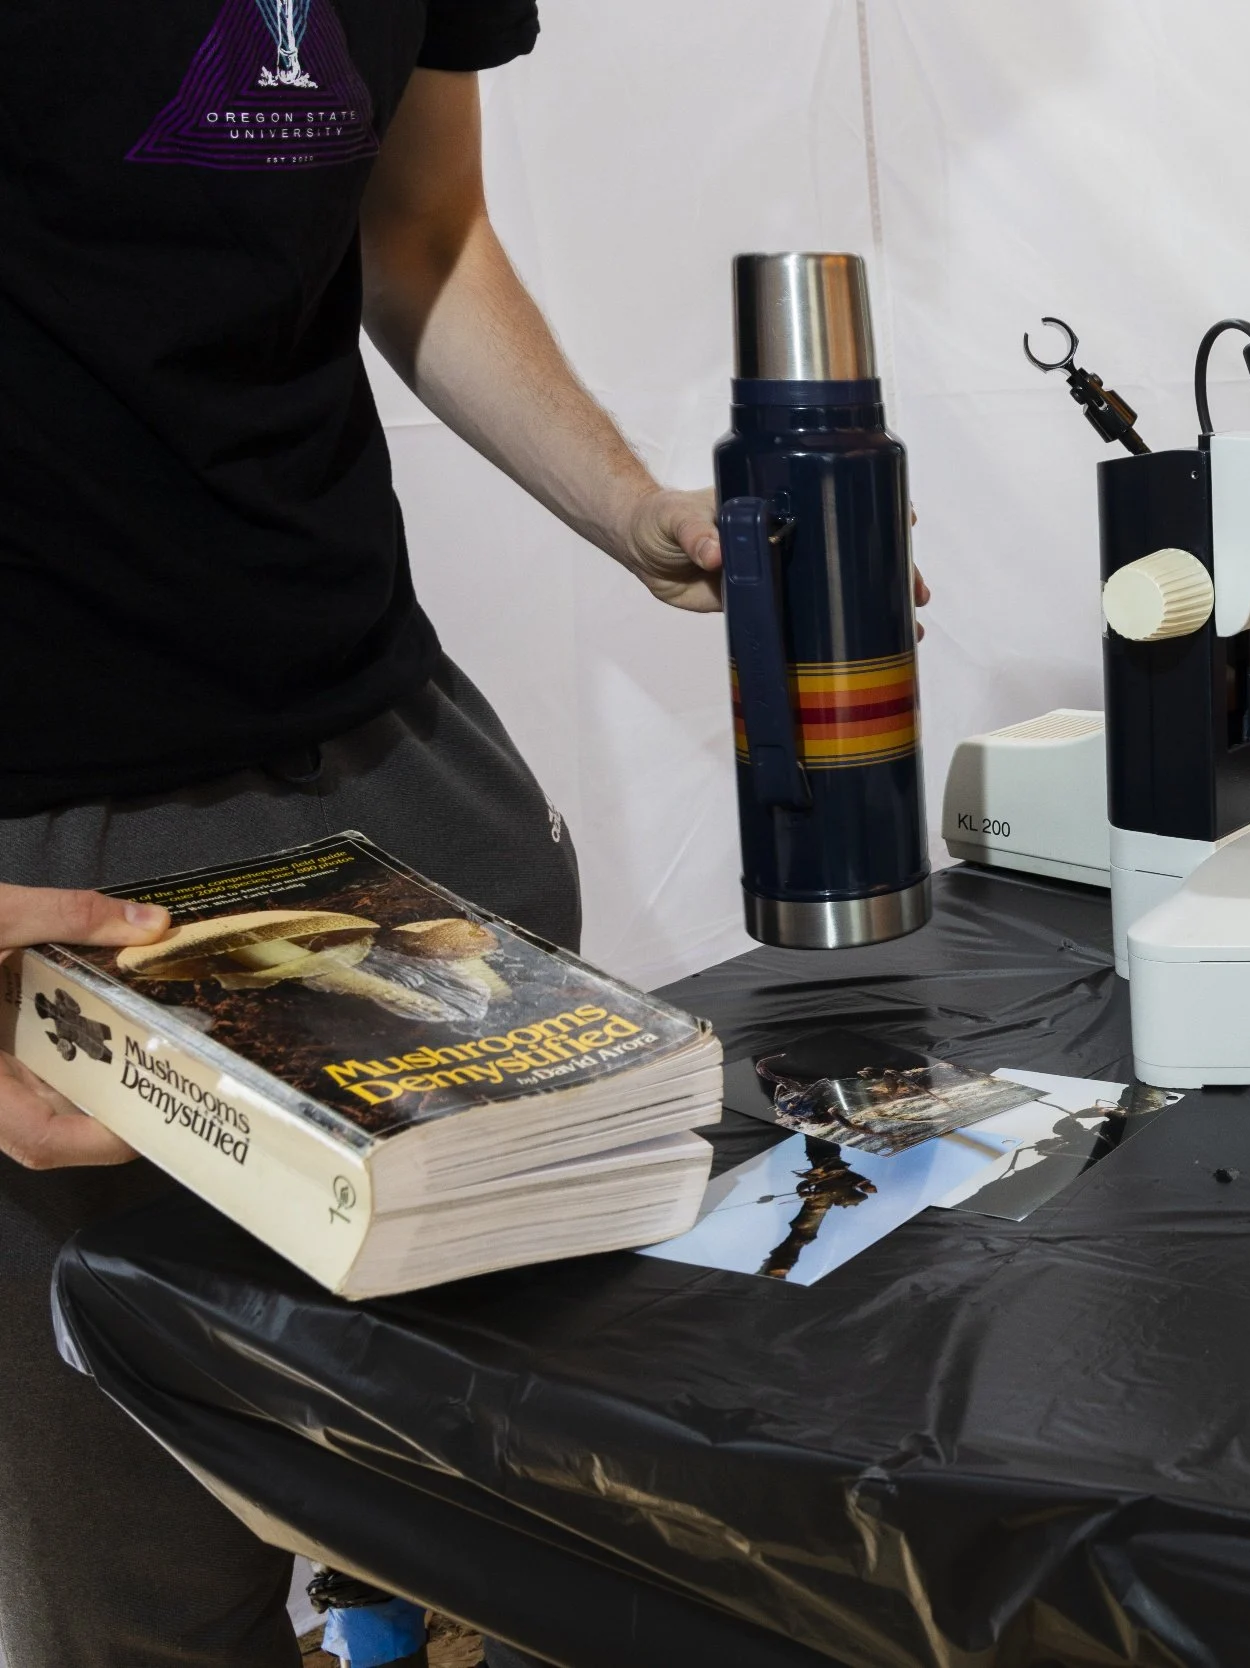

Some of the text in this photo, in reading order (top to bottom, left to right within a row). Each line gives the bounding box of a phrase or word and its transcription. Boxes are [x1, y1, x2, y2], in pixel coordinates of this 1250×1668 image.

[206, 110, 358, 123] OREGON STATE
[230, 127, 343, 139] UNIVERSITY
[958, 813, 1011, 837] KL 200
[154, 890, 174, 898] the
[177, 883, 206, 894] most
[208, 865, 290, 888] comprehensive
[291, 859, 316, 869] field
[317, 851, 348, 863] guide
[169, 893, 194, 902] over
[196, 886, 226, 897] 2000
[227, 877, 271, 891] species,
[272, 871, 295, 880] over
[319, 856, 355, 870] photos
[176, 895, 226, 908] guidebook
[322, 1003, 607, 1087] Mushrooms
[344, 1014, 643, 1106] Demystified
[516, 1032, 660, 1087] by David Arora
[125, 1035, 251, 1135] Mushrooms
[120, 1059, 250, 1166] Demystified
